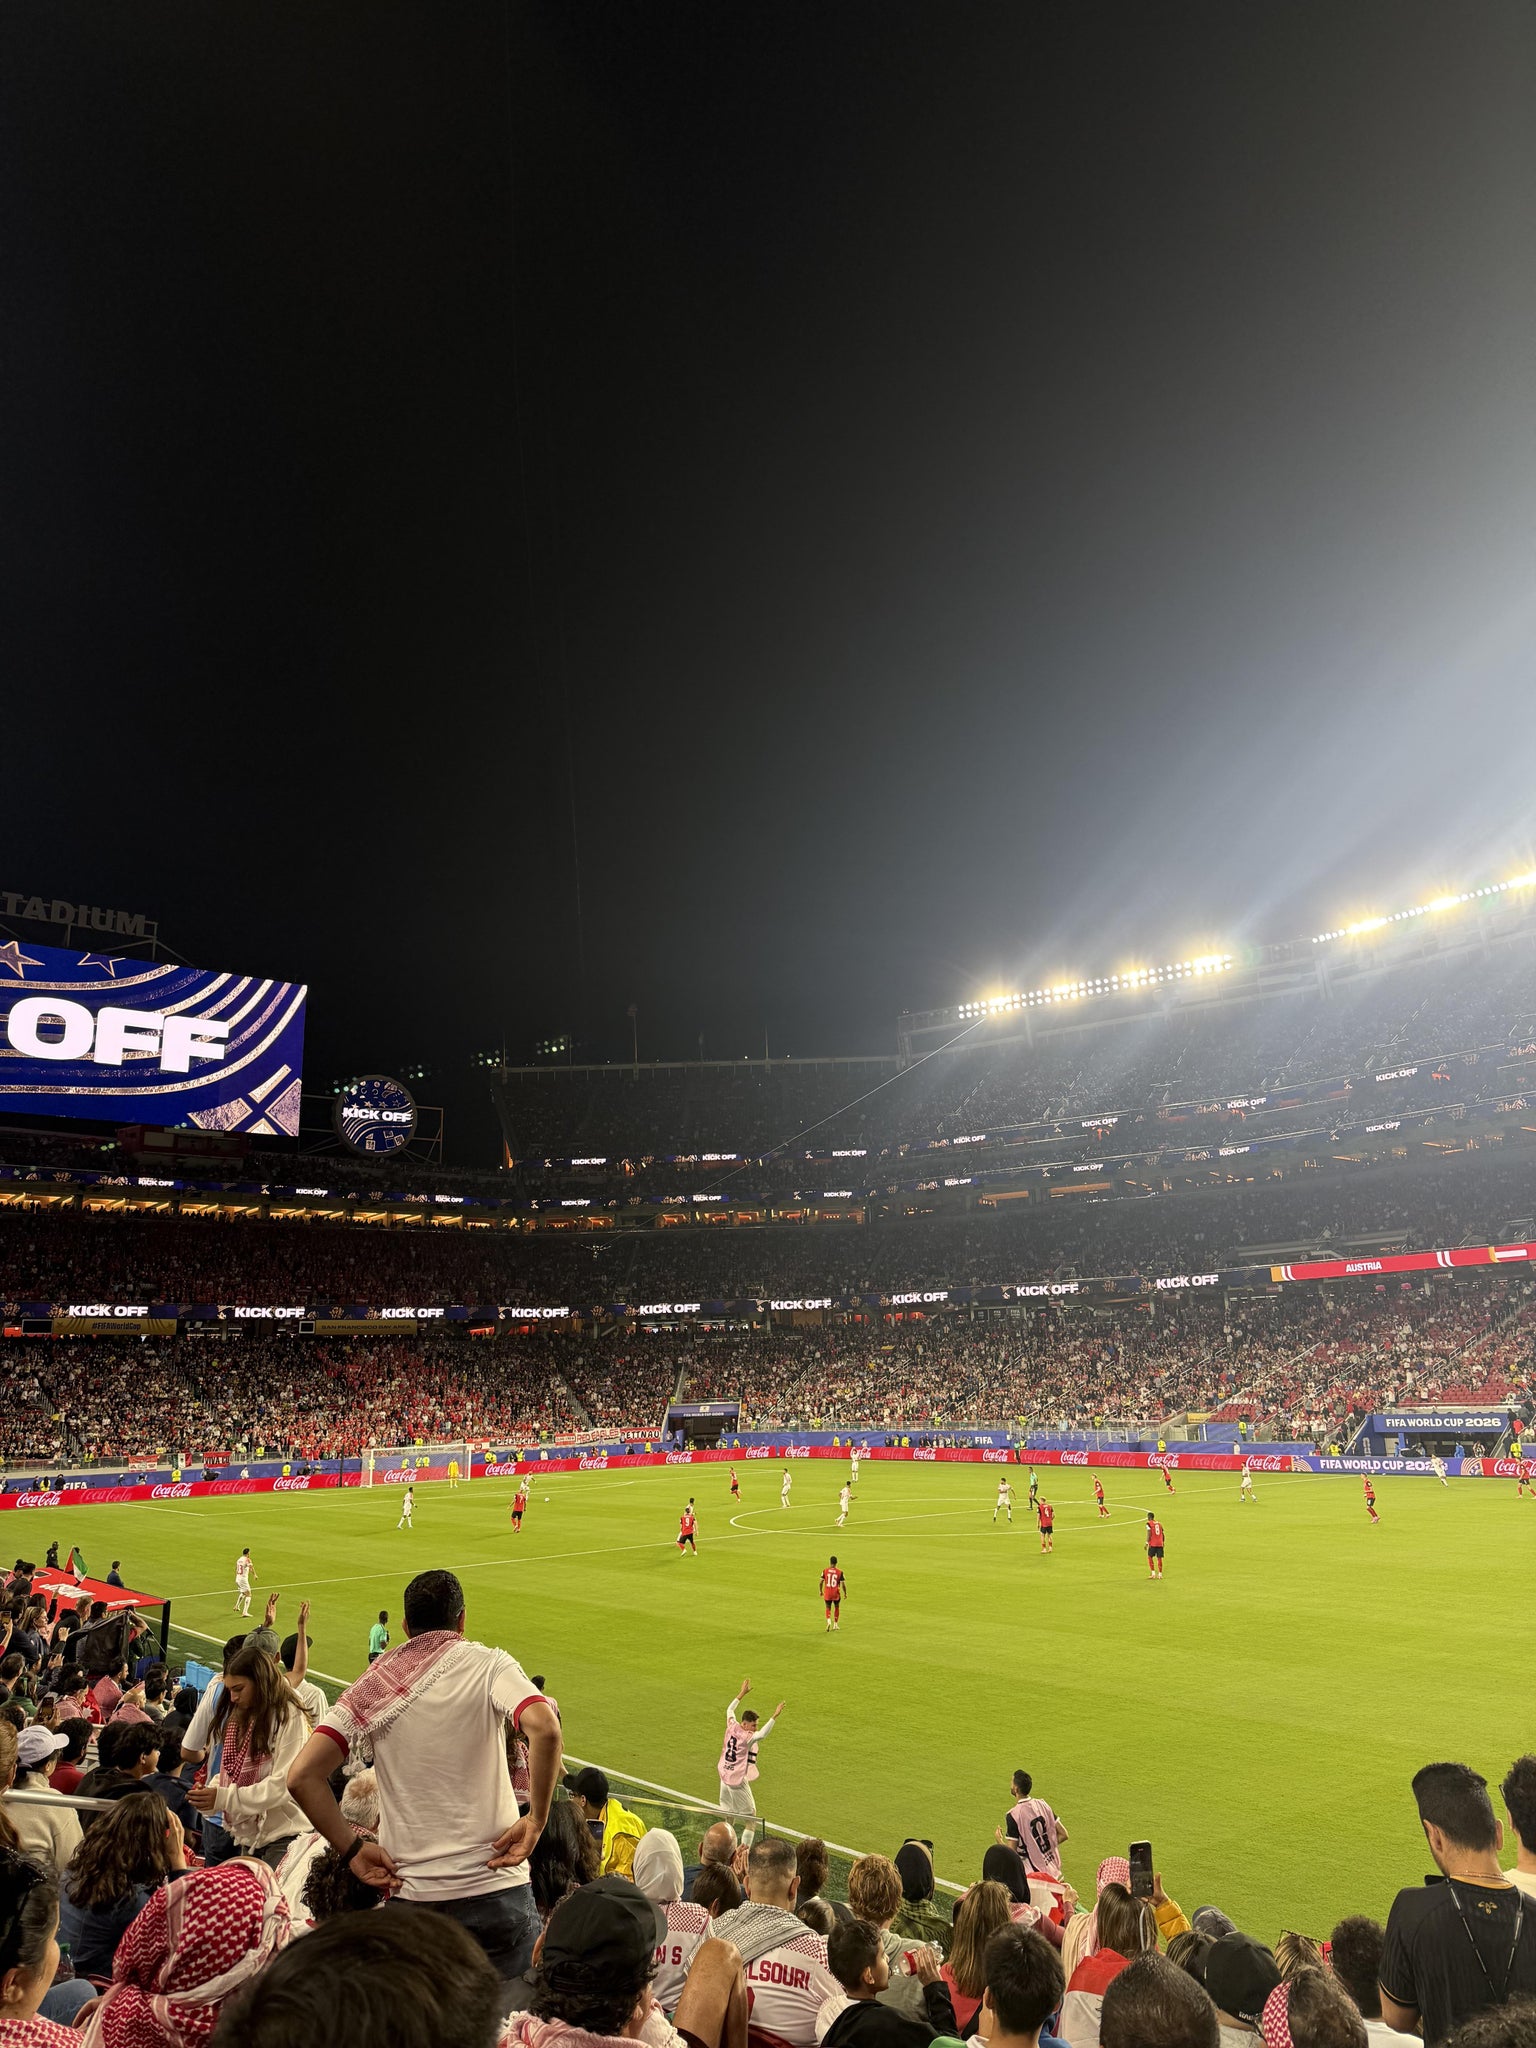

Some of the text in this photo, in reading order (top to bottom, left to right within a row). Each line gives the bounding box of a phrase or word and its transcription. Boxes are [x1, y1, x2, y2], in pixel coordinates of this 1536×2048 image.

[8, 996, 229, 1073] OFF
[1375, 1068, 1418, 1081] KICK OFF
[1227, 1097, 1267, 1109] KICK OFF
[342, 1107, 412, 1122] KICK OFF
[1366, 1121, 1400, 1132] KICK OFF
[953, 1136, 971, 1144] KICK
[1219, 1147, 1235, 1156] KICK
[138, 1179, 158, 1187] KICK
[1346, 1261, 1382, 1272] AUSTRIA
[1156, 1275, 1219, 1289] KICK OFF
[1016, 1283, 1079, 1297] KICK OFF
[892, 1291, 948, 1304] KICK OFF
[639, 1303, 700, 1315] KICK OFF
[771, 1299, 832, 1310] KICK OFF
[69, 1305, 149, 1317] KICK OFF
[235, 1307, 305, 1318] KICK OFF
[382, 1308, 445, 1318] KICK OFF
[512, 1307, 569, 1318] KICK OFF
[1386, 1417, 1501, 1428] FIFA WORLD CUP 2026
[577, 1434, 590, 1443] RED
[591, 1428, 619, 1441] EAGLES
[974, 1436, 994, 1445] FIFA
[1320, 1460, 1342, 1469] FIFA
[1343, 1460, 1382, 1470] WORLD
[1384, 1461, 1404, 1470] CUP
[63, 1482, 88, 1490] FIFA
[685, 1517, 690, 1527] 9
[1154, 1524, 1160, 1536] 8
[826, 1573, 838, 1588] 16
[671, 1945, 683, 1965] S
